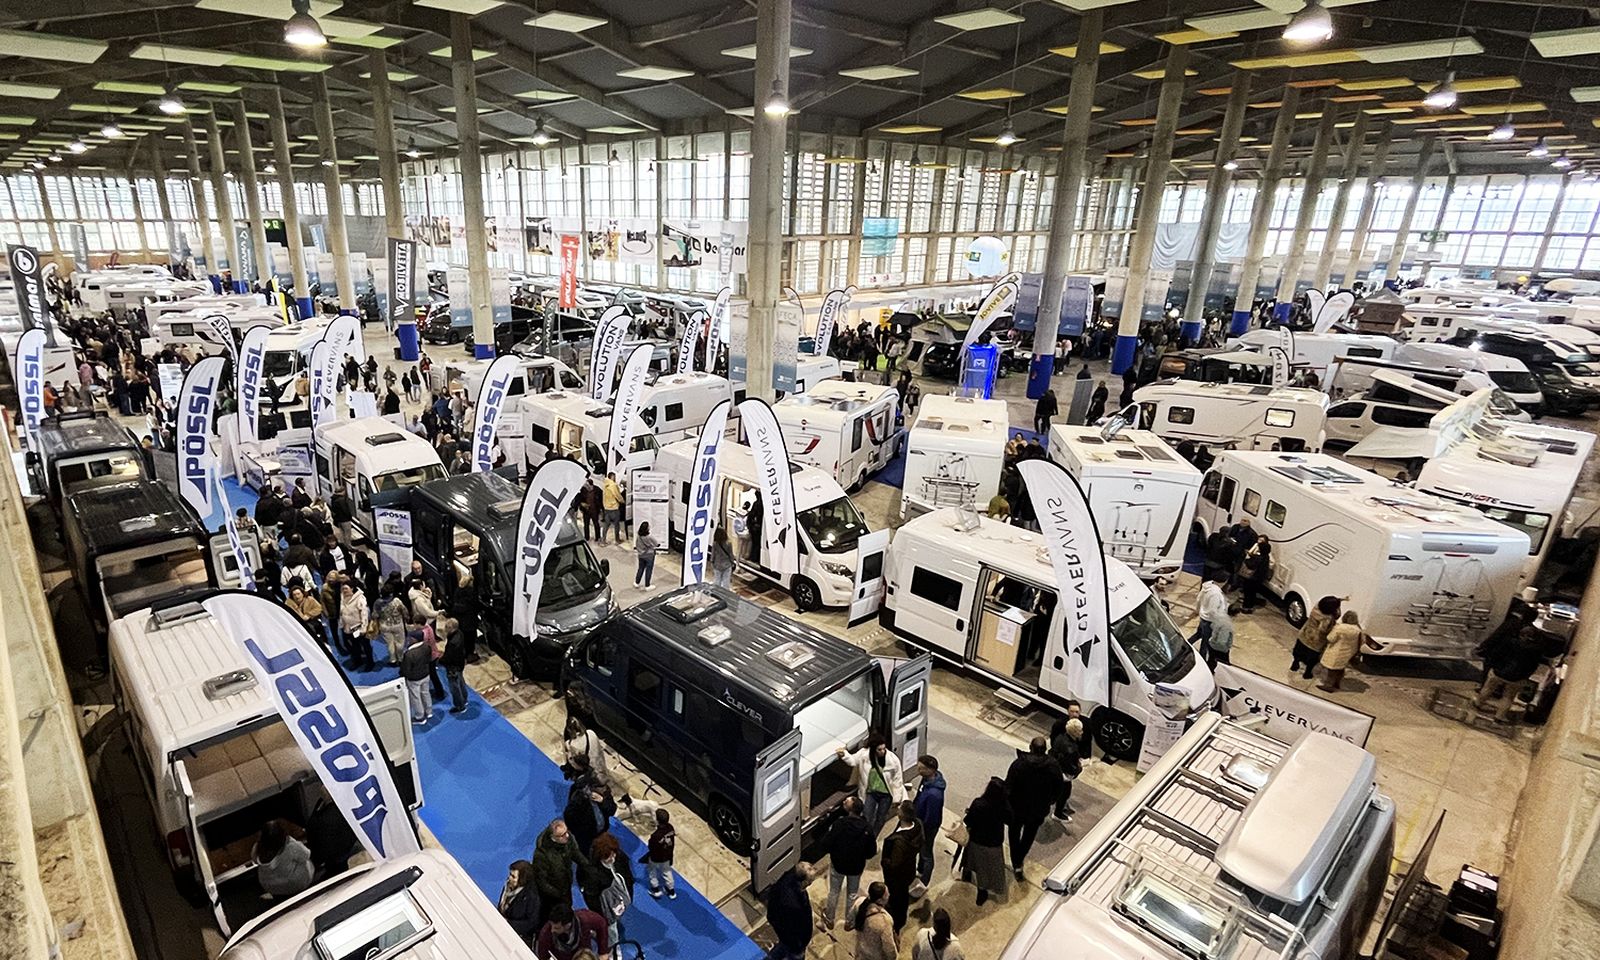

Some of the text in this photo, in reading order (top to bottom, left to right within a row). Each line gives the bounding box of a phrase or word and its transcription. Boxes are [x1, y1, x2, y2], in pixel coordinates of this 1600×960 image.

[397, 243, 407, 300] MOBILVETTA
[704, 238, 745, 256] bear
[326, 331, 344, 394] CLEVERVANS
[182, 377, 214, 477] PÖSSL
[478, 373, 509, 462] PÖSSL
[619, 366, 641, 446] CLEVERVANS
[690, 430, 720, 562] PÖSSL
[1463, 492, 1500, 504] PILOTE
[726, 696, 763, 723] CLEVER
[1244, 697, 1354, 744] CLEVERVANS
